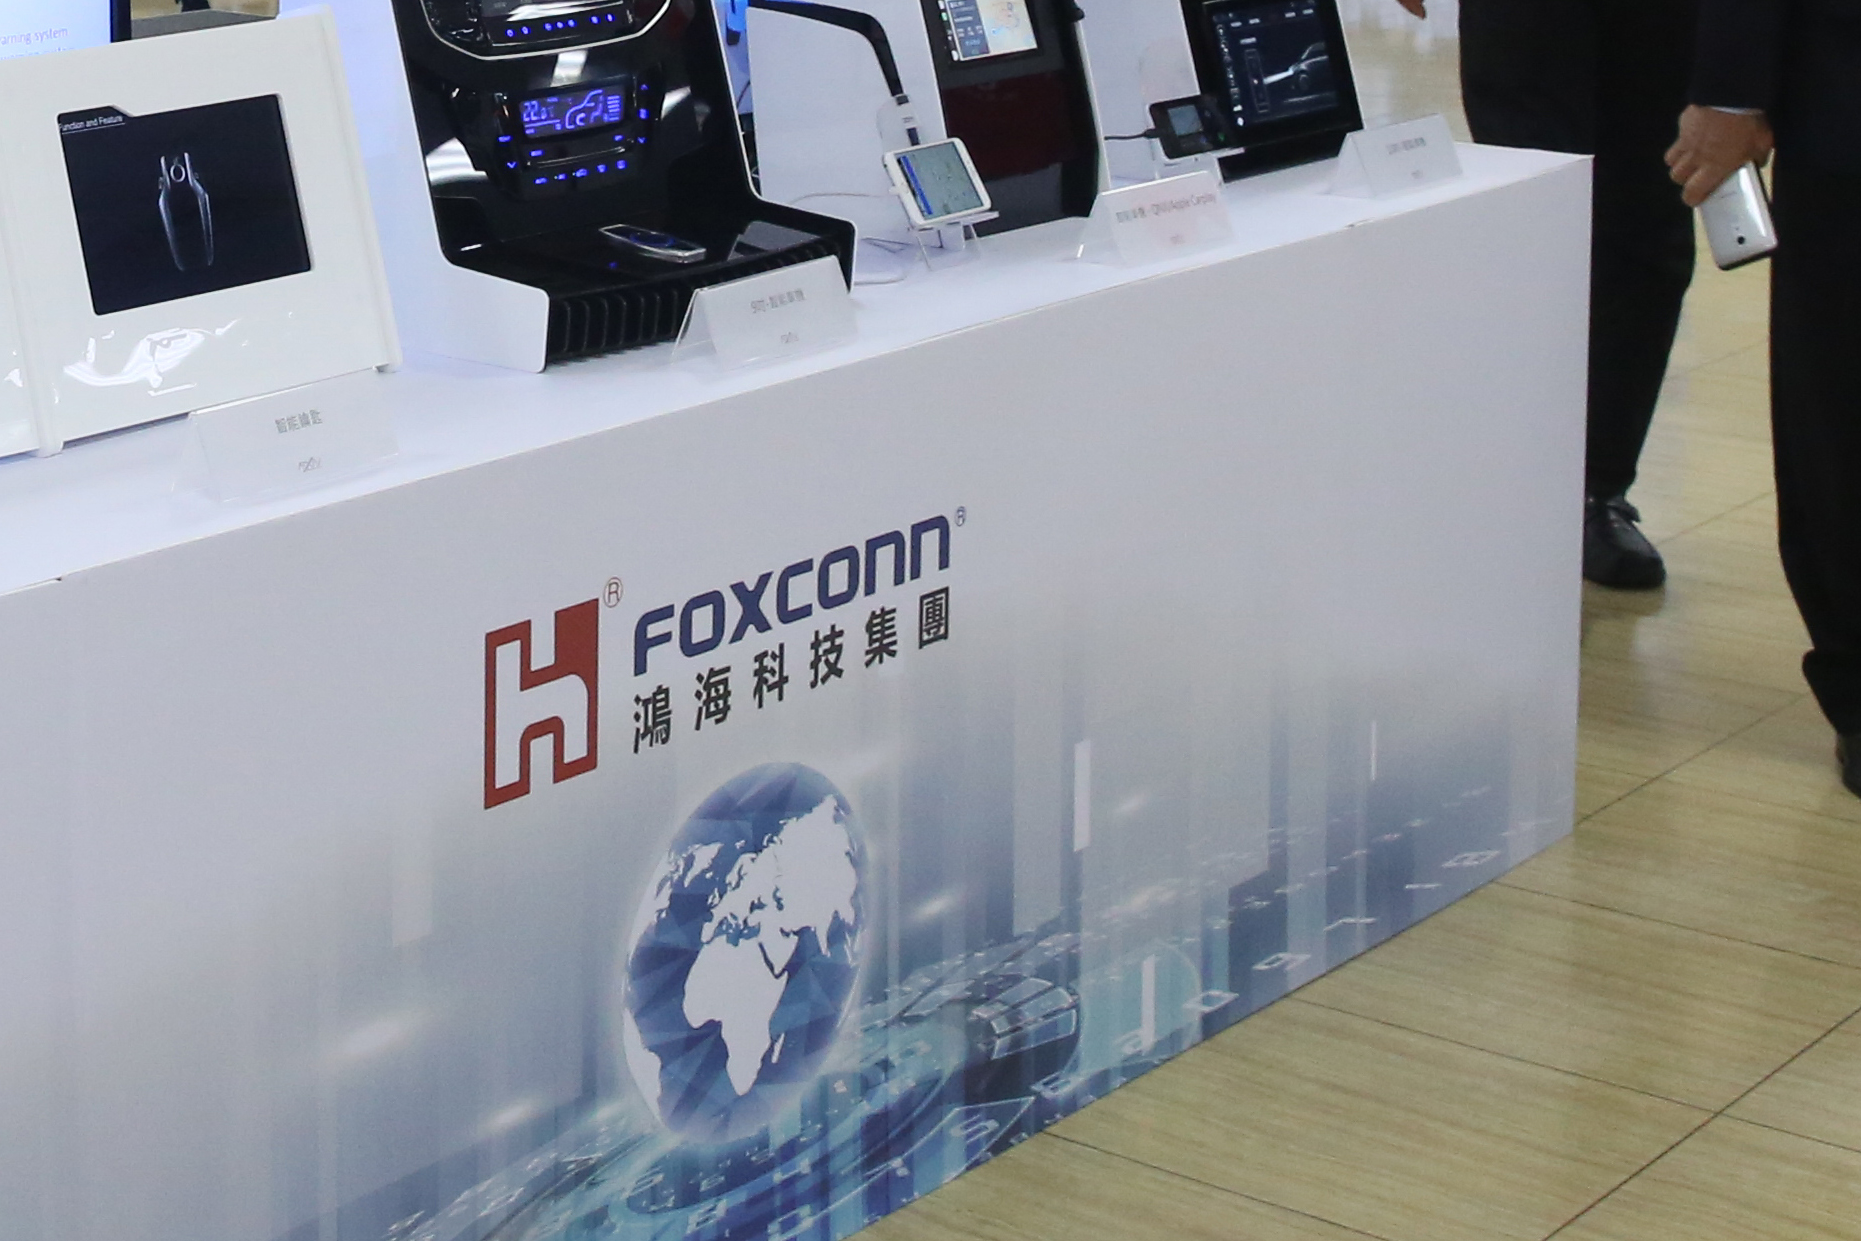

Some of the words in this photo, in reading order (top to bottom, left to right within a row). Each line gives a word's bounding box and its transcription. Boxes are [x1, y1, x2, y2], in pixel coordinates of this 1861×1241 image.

[34, 25, 69, 44] system
[632, 586, 951, 754] 鴻海科技集團
[633, 514, 951, 677] FOXCONN
